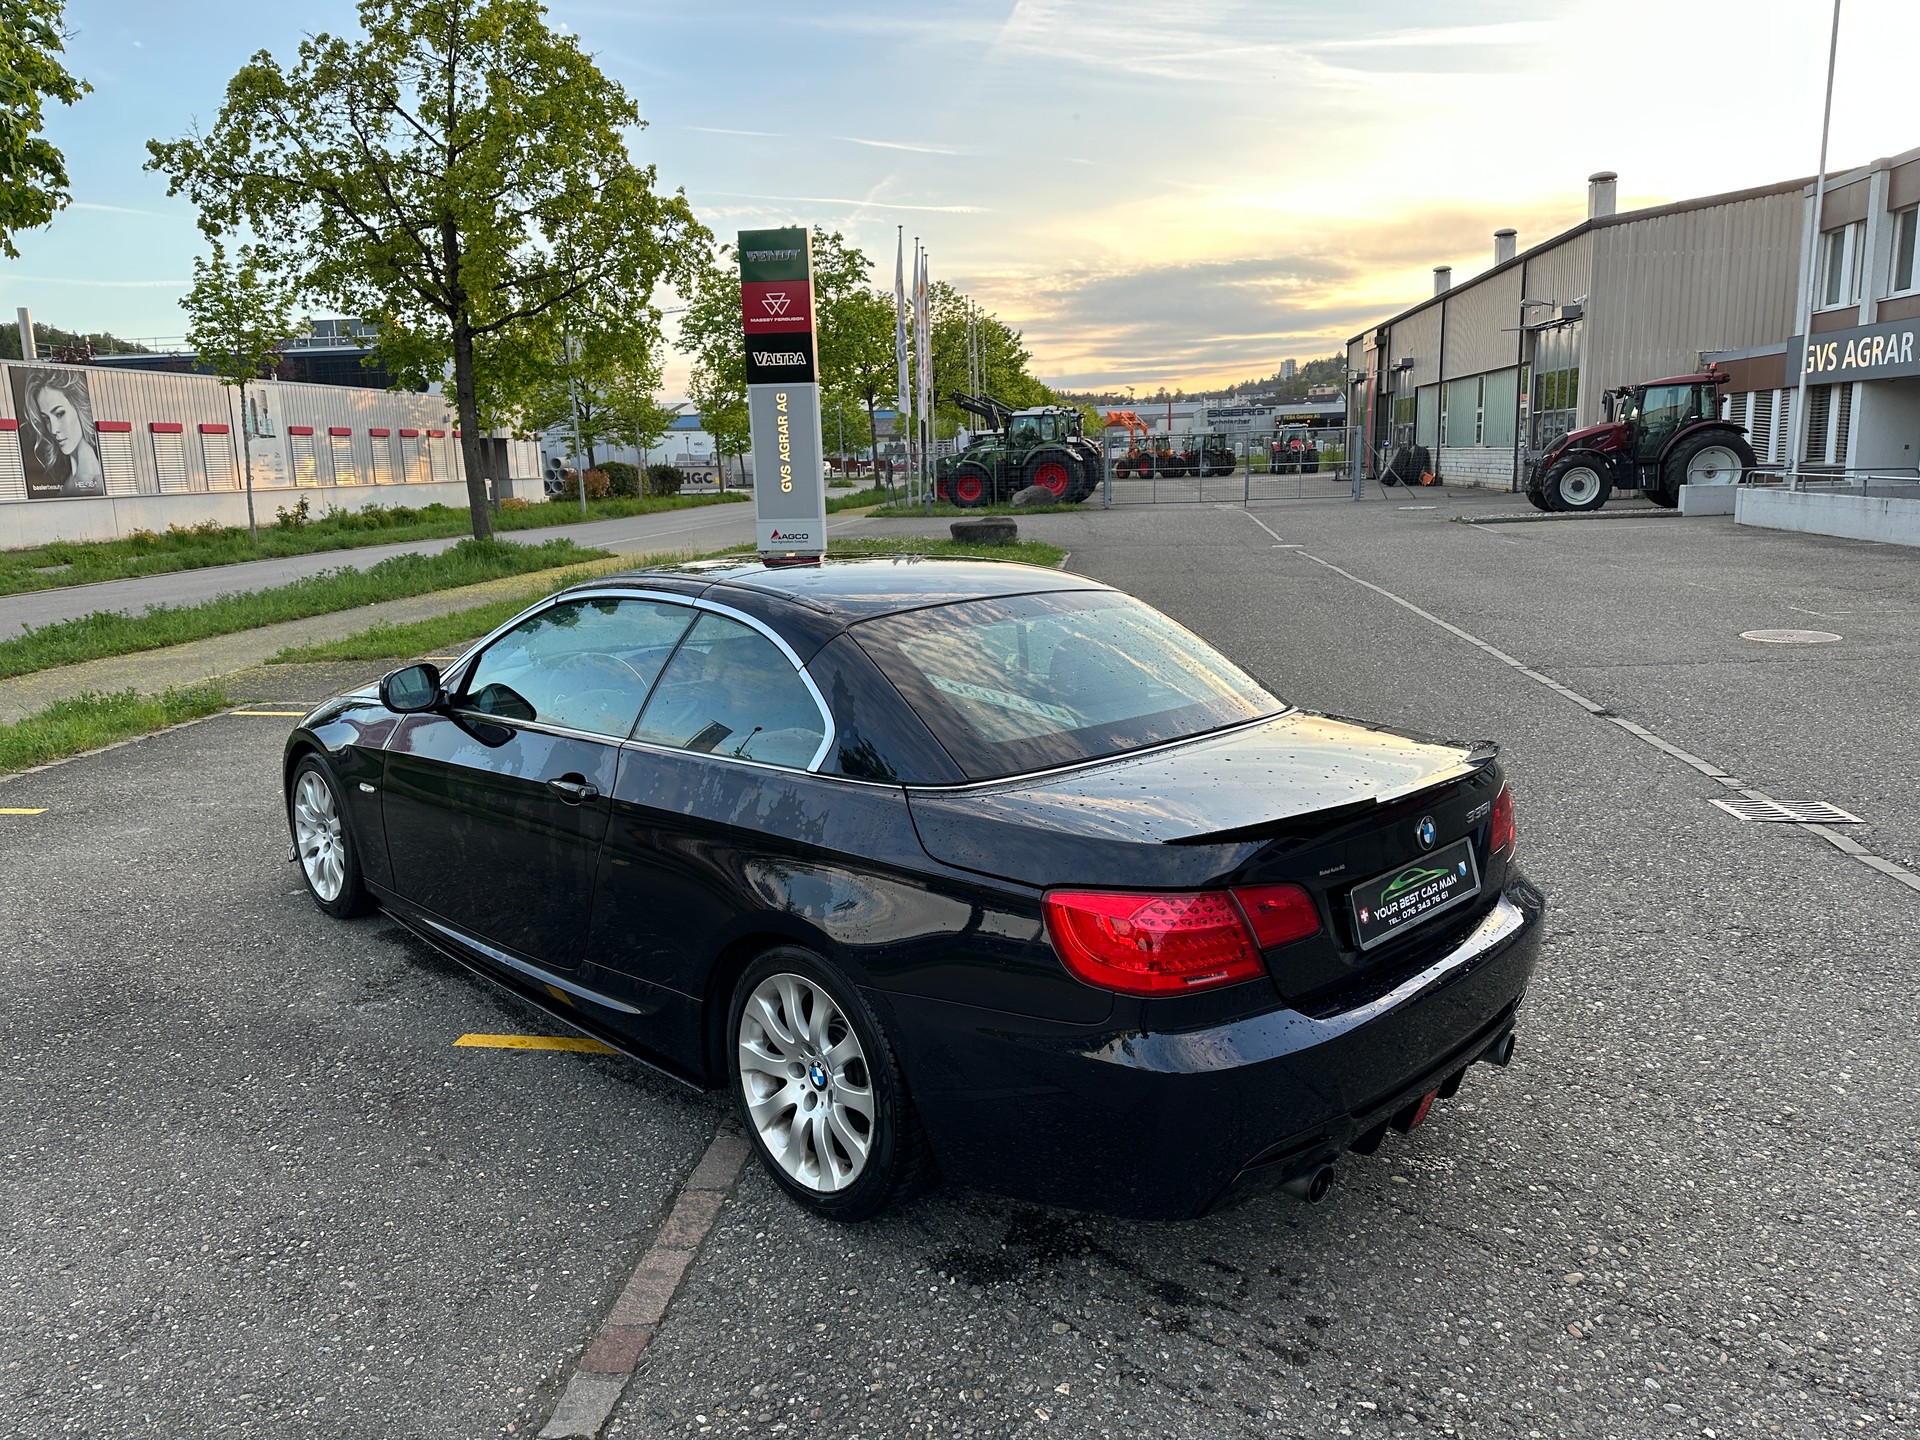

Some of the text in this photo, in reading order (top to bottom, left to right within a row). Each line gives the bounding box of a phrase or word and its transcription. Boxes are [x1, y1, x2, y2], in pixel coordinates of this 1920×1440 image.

[746, 249, 800, 262] FENDT
[1806, 331, 1914, 374] GVS AGRAR
[1207, 406, 1276, 417] SIGERIST
[775, 392, 793, 493] GVS AGRAR AG
[681, 472, 714, 485] HGC
[1466, 800, 1491, 824] 335i
[1373, 873, 1457, 921] YOUR BEST CAR MAN
[1402, 906, 1416, 919] 076
[1416, 898, 1431, 912] 343
[1431, 894, 1440, 905] 76
[1441, 890, 1449, 899] 61
